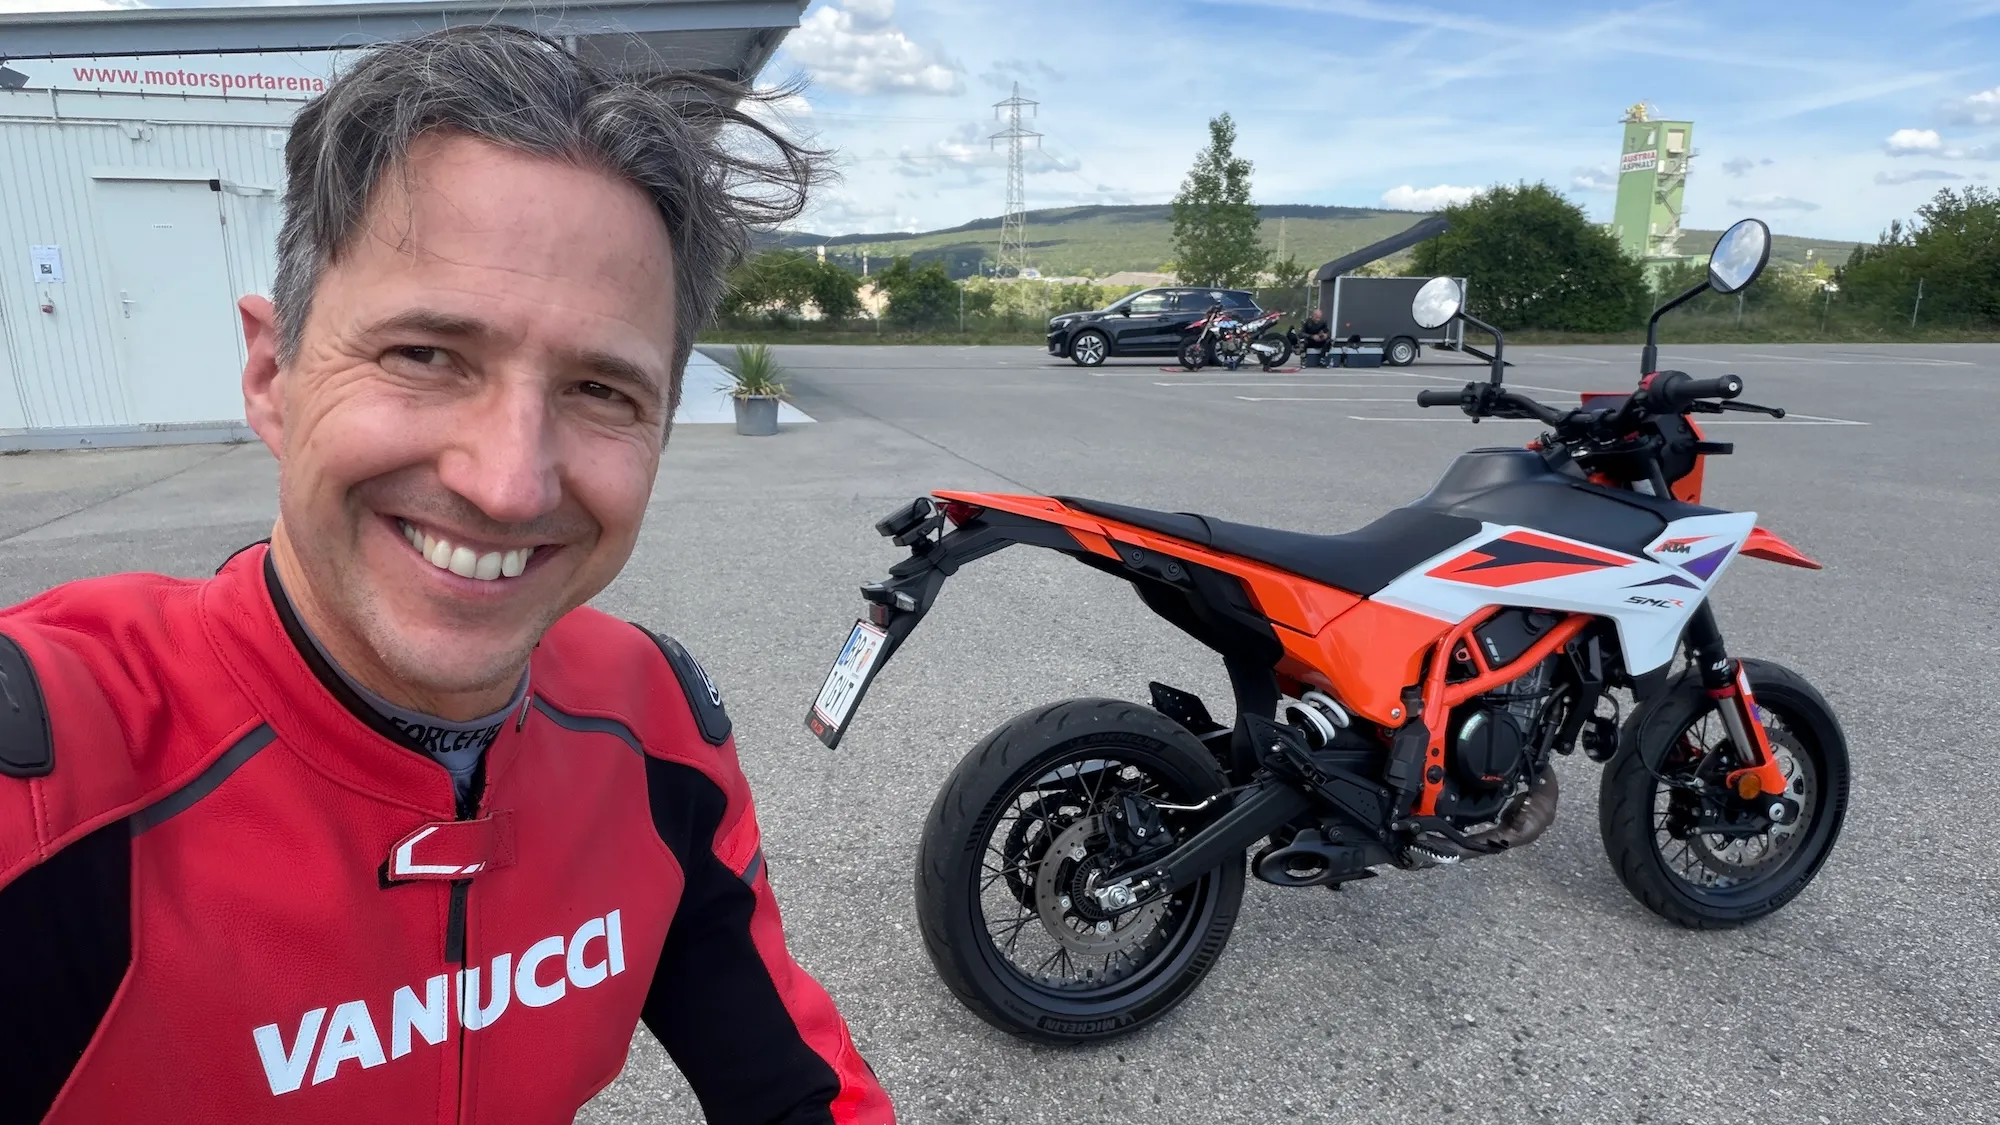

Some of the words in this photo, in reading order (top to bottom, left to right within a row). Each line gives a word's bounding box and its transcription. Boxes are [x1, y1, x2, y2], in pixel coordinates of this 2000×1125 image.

[73, 67, 324, 93] www.motorsportarena
[1624, 152, 1656, 162] AUSTRIA
[1623, 160, 1656, 170] ASPHALT
[1661, 543, 1691, 554] KTM
[253, 908, 626, 1096] VANUCCI
[1042, 1018, 1116, 1034] MICHELIN
